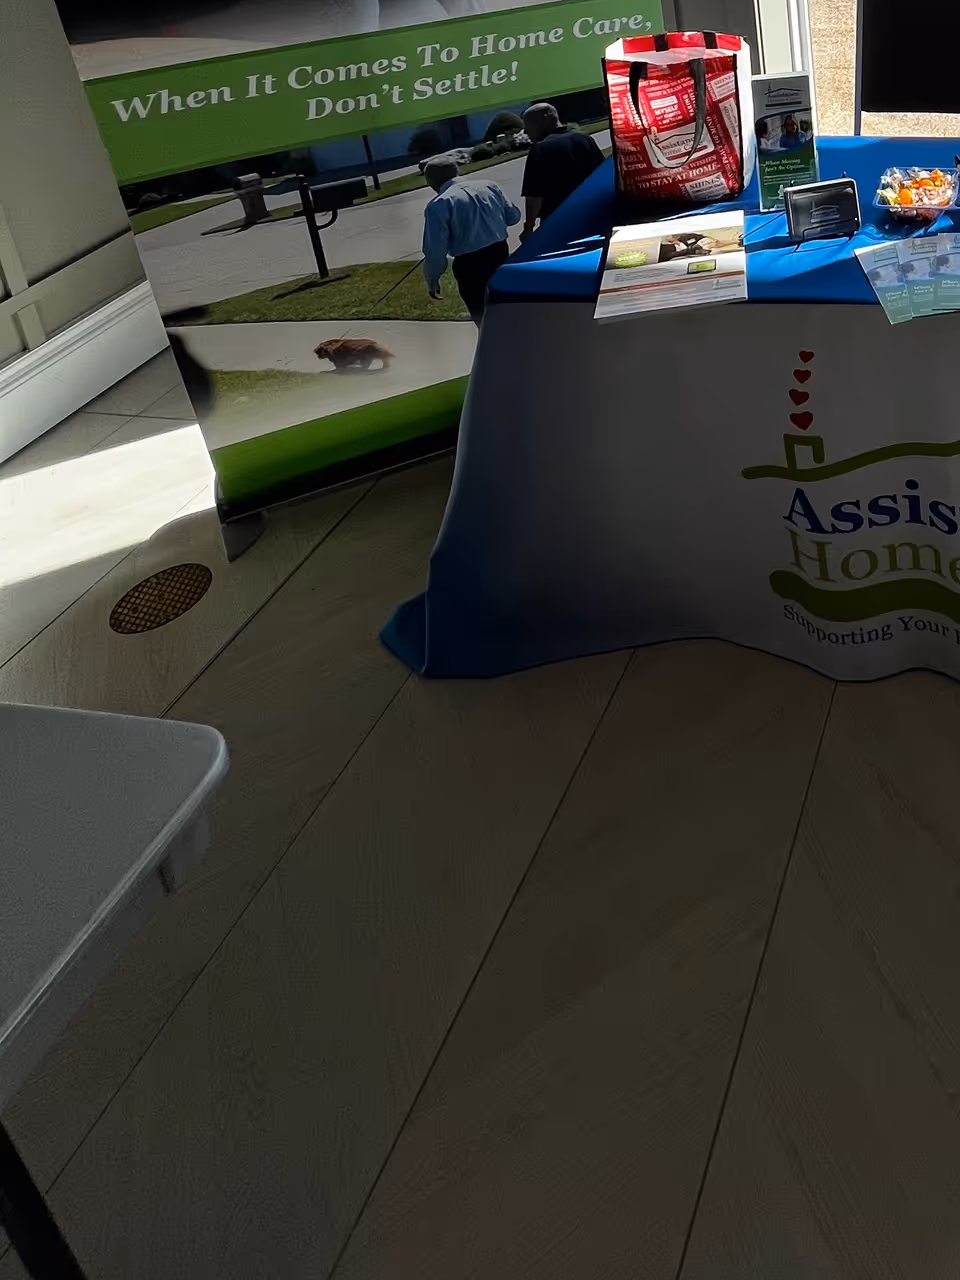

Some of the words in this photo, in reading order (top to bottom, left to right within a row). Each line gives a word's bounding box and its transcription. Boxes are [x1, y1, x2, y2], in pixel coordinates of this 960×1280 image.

[110, 83, 234, 121] When
[246, 73, 276, 98] It
[287, 55, 407, 89] Comes
[417, 43, 459, 67] To
[470, 29, 565, 59] Home
[572, 14, 653, 40] Care,
[306, 83, 405, 120] Don't
[413, 60, 520, 100] Settle!
[650, 176, 674, 187] STAY
[675, 172, 686, 182] AT
[783, 604, 894, 646] Supporting
[896, 615, 950, 639] Your
